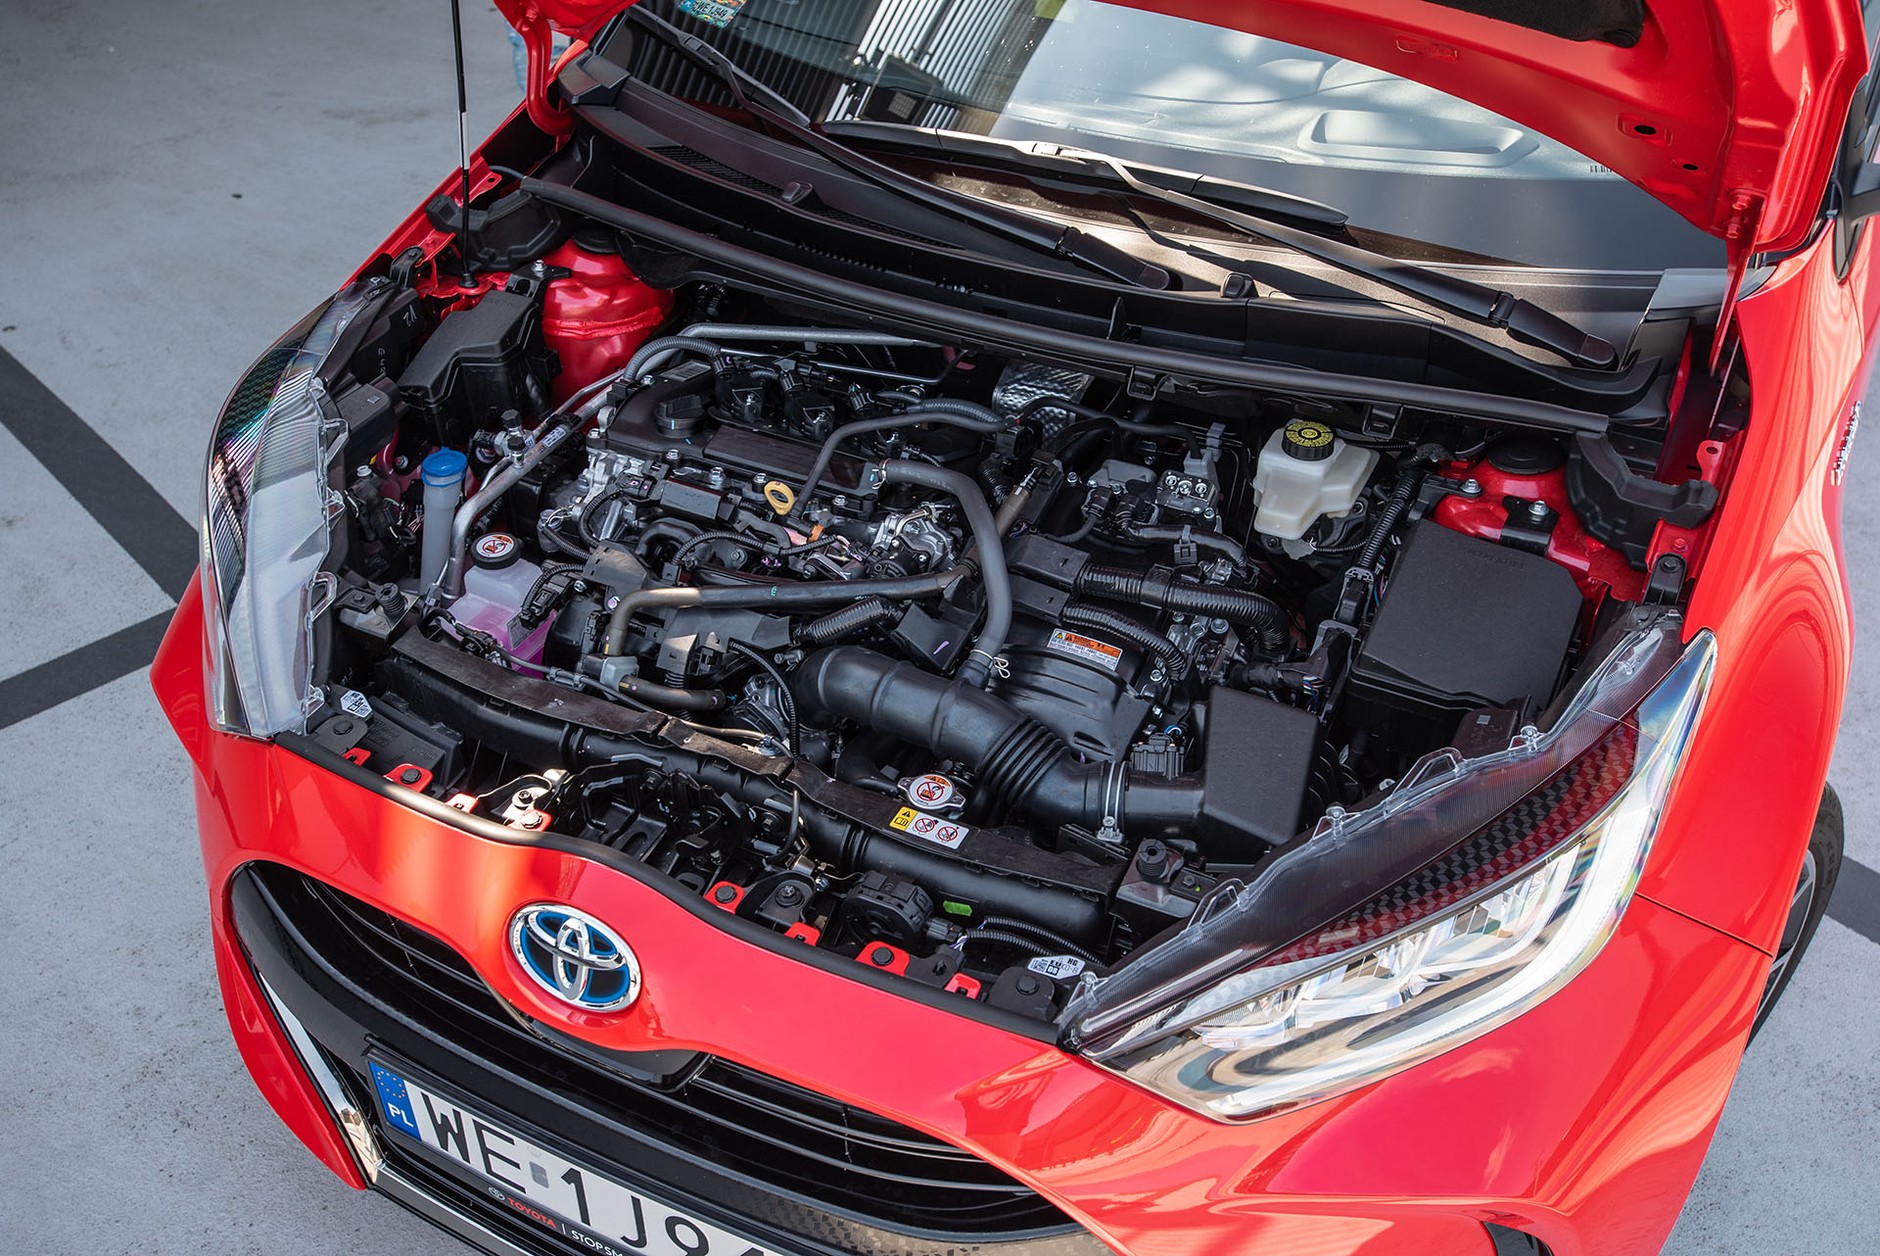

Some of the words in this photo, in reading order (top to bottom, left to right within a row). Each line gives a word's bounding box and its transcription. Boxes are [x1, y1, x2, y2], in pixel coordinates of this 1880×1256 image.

[388, 1102, 414, 1128] PL
[420, 1091, 527, 1195] WE
[560, 1167, 767, 1256] 1J9
[506, 1197, 557, 1229] TOYOTA
[571, 1230, 603, 1251] STOP
